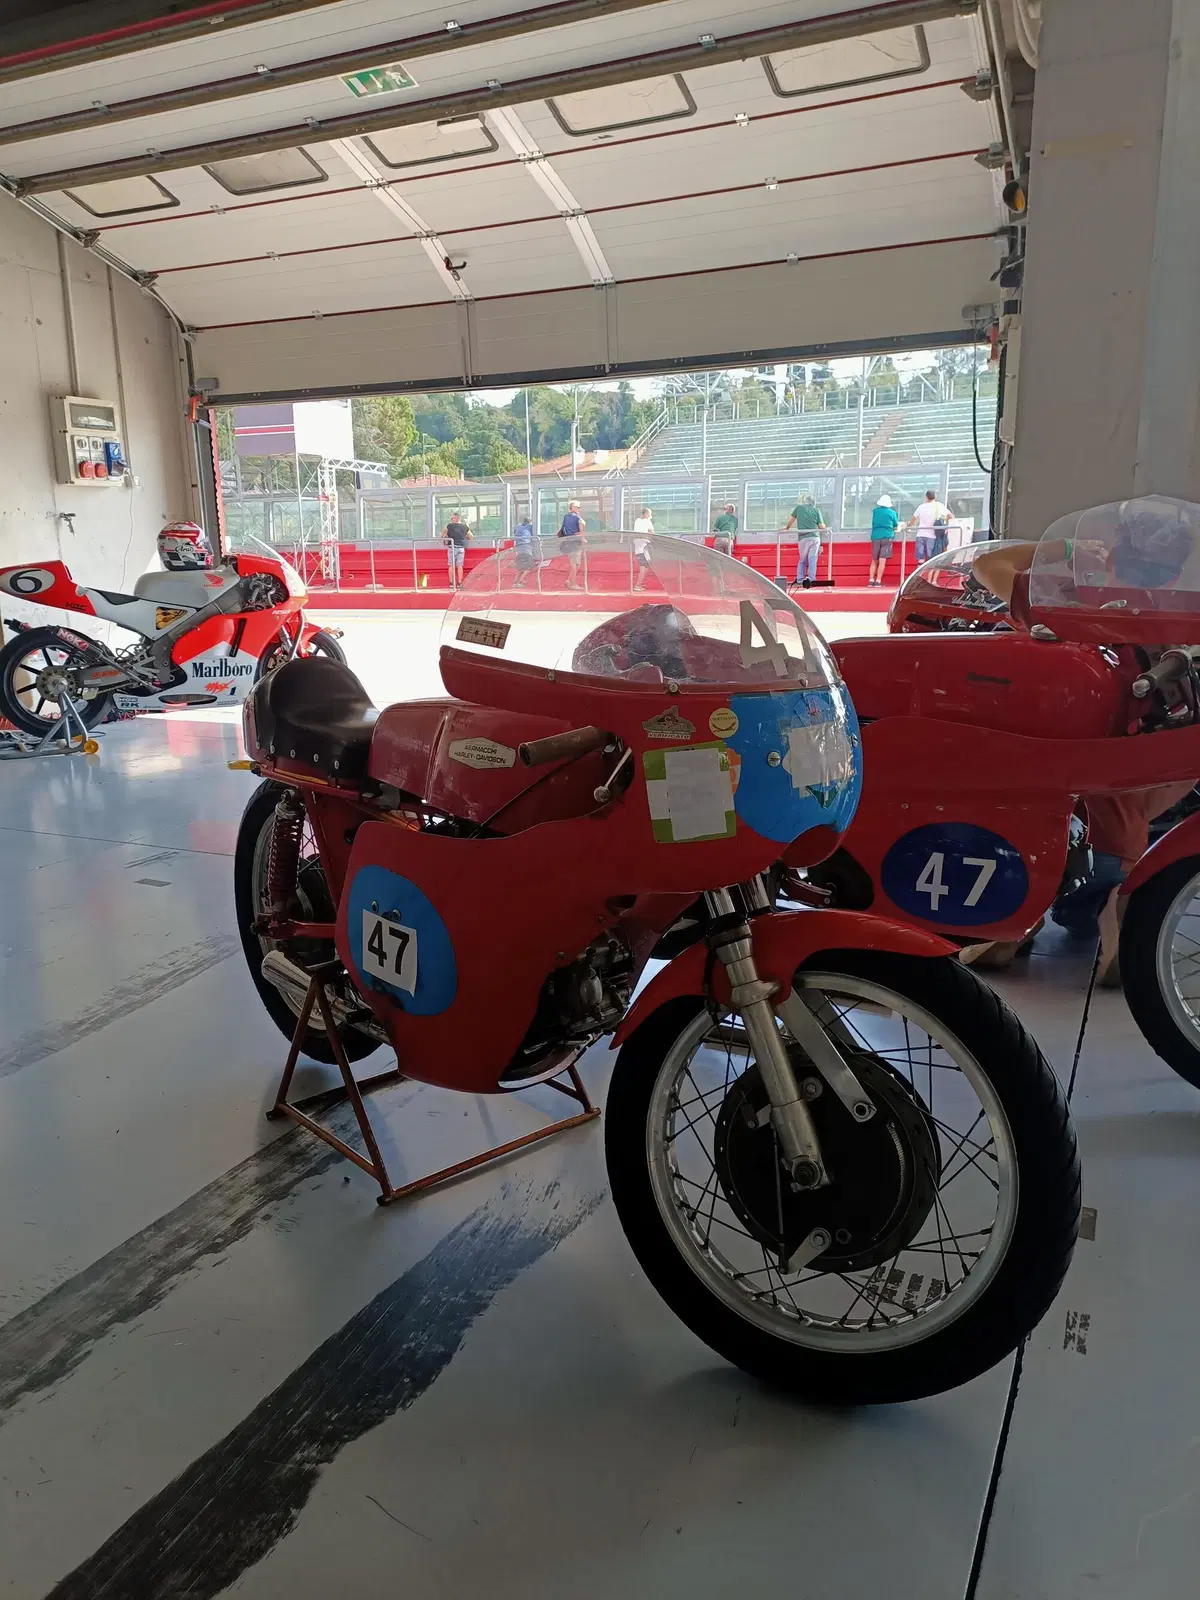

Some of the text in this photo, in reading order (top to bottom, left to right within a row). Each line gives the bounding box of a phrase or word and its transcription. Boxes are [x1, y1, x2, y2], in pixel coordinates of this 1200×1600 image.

[9, 569, 43, 594] 6
[57, 628, 81, 647] NGK
[739, 598, 818, 677] 47
[191, 658, 253, 678] Marlboro
[453, 751, 507, 764] HARLEY-DAVIDSON
[464, 744, 498, 755] AERMACCHI
[914, 851, 998, 912] 47
[367, 919, 411, 976] 47
